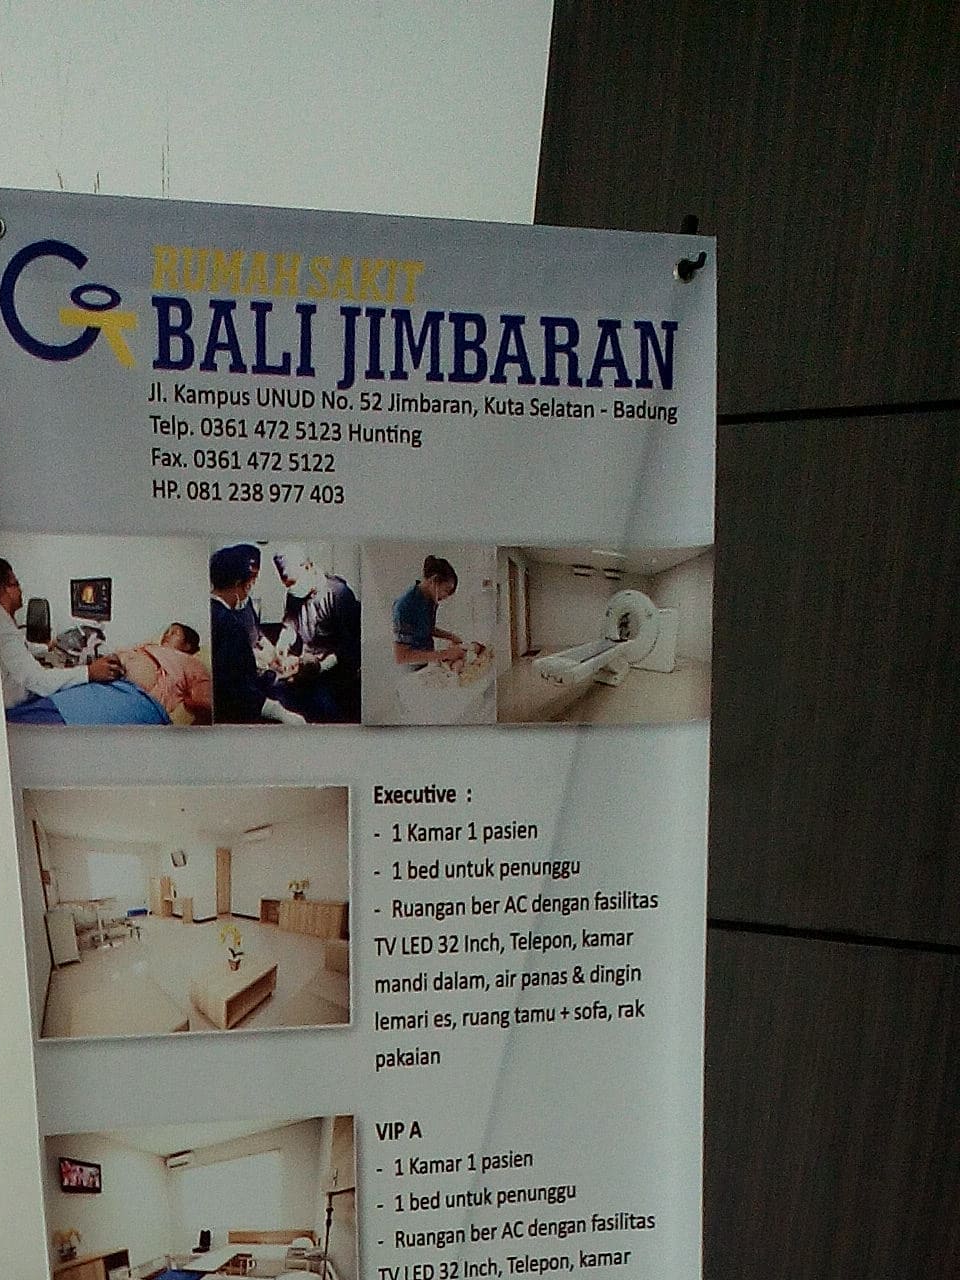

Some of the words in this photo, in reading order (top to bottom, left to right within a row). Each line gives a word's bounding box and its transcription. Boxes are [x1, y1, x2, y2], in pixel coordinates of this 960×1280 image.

[151, 245, 302, 296] RUMAH
[306, 256, 425, 304] SAKIT
[152, 295, 316, 380] BALI
[336, 305, 679, 391] JIMBARAN
[148, 382, 166, 402] Jl.
[174, 384, 250, 409] Kampus
[257, 388, 315, 408] UNUD
[322, 391, 354, 410] No.
[360, 392, 382, 411] 52
[388, 393, 478, 418] Jimbaran,
[484, 396, 525, 416] Kuta
[530, 398, 594, 419] Selatan
[613, 401, 678, 424] Badung
[150, 416, 194, 439] Telp.
[200, 418, 248, 438] 0361
[254, 420, 289, 439] 472
[296, 421, 342, 441] 5123
[348, 424, 422, 447] Hunting
[152, 448, 188, 468] Fax.
[194, 450, 241, 470] 0361
[248, 452, 282, 471] 472
[289, 453, 335, 472] 5122
[152, 480, 180, 499] HP.
[187, 482, 222, 500] 081
[228, 483, 264, 502] 238
[269, 484, 304, 503] 977
[310, 486, 344, 504] 403
[374, 784, 456, 804] Executive
[408, 823, 462, 842] Kamar
[483, 821, 538, 844] pasien
[408, 859, 439, 880] bed
[445, 858, 494, 878] untuk
[500, 858, 580, 880] penunggu
[392, 900, 465, 920] Ruangan
[472, 896, 500, 914] ber
[504, 895, 528, 914] AC
[532, 894, 590, 916] dengan
[594, 890, 658, 910] fasilitas
[374, 937, 396, 956] TV
[402, 936, 432, 955] LED
[438, 935, 459, 954] 32
[464, 933, 505, 954] Inch,
[510, 931, 576, 954] Telepon,
[582, 929, 634, 948] kamar
[375, 972, 428, 994] mandi
[434, 971, 490, 992] dalam,
[495, 970, 516, 988] air
[521, 969, 568, 990] panas
[590, 964, 642, 986] dingin
[375, 1010, 428, 1030] lemari
[434, 1013, 456, 1030] es,
[462, 1007, 510, 1028] ruang
[514, 1006, 555, 1024] tamu
[574, 1001, 612, 1022] sofa,
[618, 999, 645, 1018] rak
[376, 1048, 440, 1072] pakaian
[376, 1122, 405, 1141] VIP
[409, 1121, 422, 1138] A
[410, 1155, 462, 1174] Kamar
[482, 1150, 533, 1173] pasien
[410, 1191, 440, 1211] bed
[446, 1188, 491, 1208] untuk
[497, 1184, 576, 1208] penunggu
[396, 1229, 465, 1249] Ruangan
[470, 1224, 498, 1242] ber
[502, 1222, 524, 1240] AC
[528, 1218, 586, 1238] dengan
[592, 1212, 656, 1232] fasilitas
[440, 1262, 458, 1280] 32
[464, 1258, 502, 1278] Inch,
[507, 1254, 574, 1276] Telepon,
[580, 1250, 632, 1268] kamar
